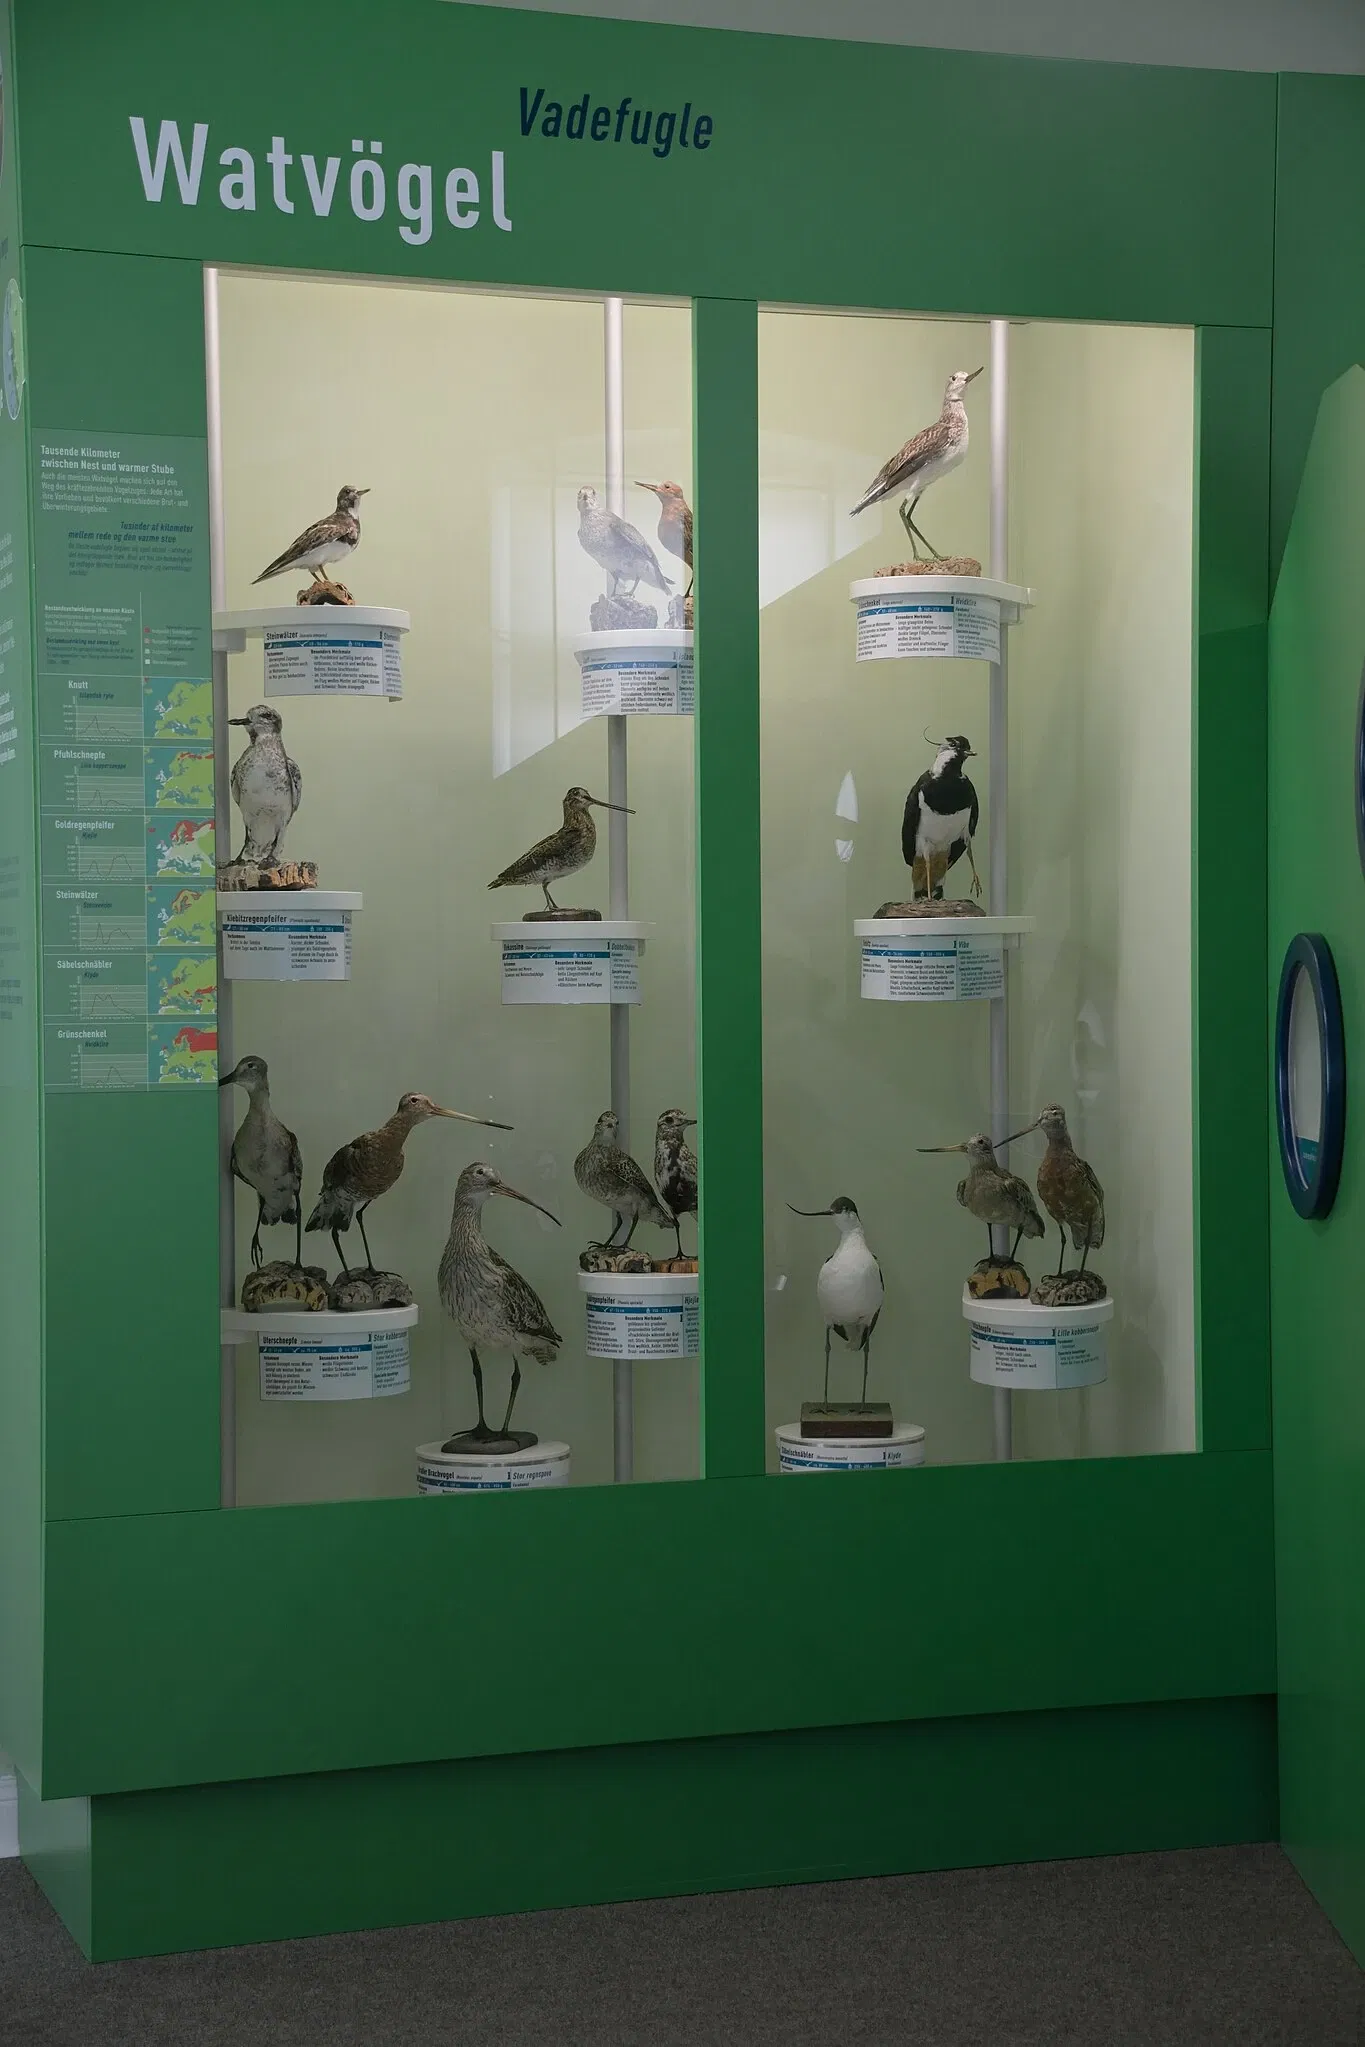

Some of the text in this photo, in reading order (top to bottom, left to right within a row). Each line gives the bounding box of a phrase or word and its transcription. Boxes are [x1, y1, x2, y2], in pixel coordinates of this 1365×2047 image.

[519, 87, 714, 159] Vadefugle
[129, 116, 513, 246] Watvögel
[41, 445, 120, 459] Tausende Kilometer
[41, 459, 174, 474] zwischen Nest und warmer Stube
[68, 531, 94, 540] mellem
[96, 532, 112, 540] rede
[123, 533, 137, 542] den
[266, 632, 298, 640] Steinwälzer
[69, 680, 88, 689] Knutt
[54, 750, 106, 760] Pfuhlschnepfe
[55, 820, 115, 831] Goldregenpfeifer
[56, 890, 99, 900] Steinwälzer
[227, 915, 287, 924] Kiebitzregenpfeifer
[57, 960, 113, 969] Säbelschnäbler
[58, 1030, 107, 1039] Grünschenkel
[513, 1472, 525, 1480] Stor
